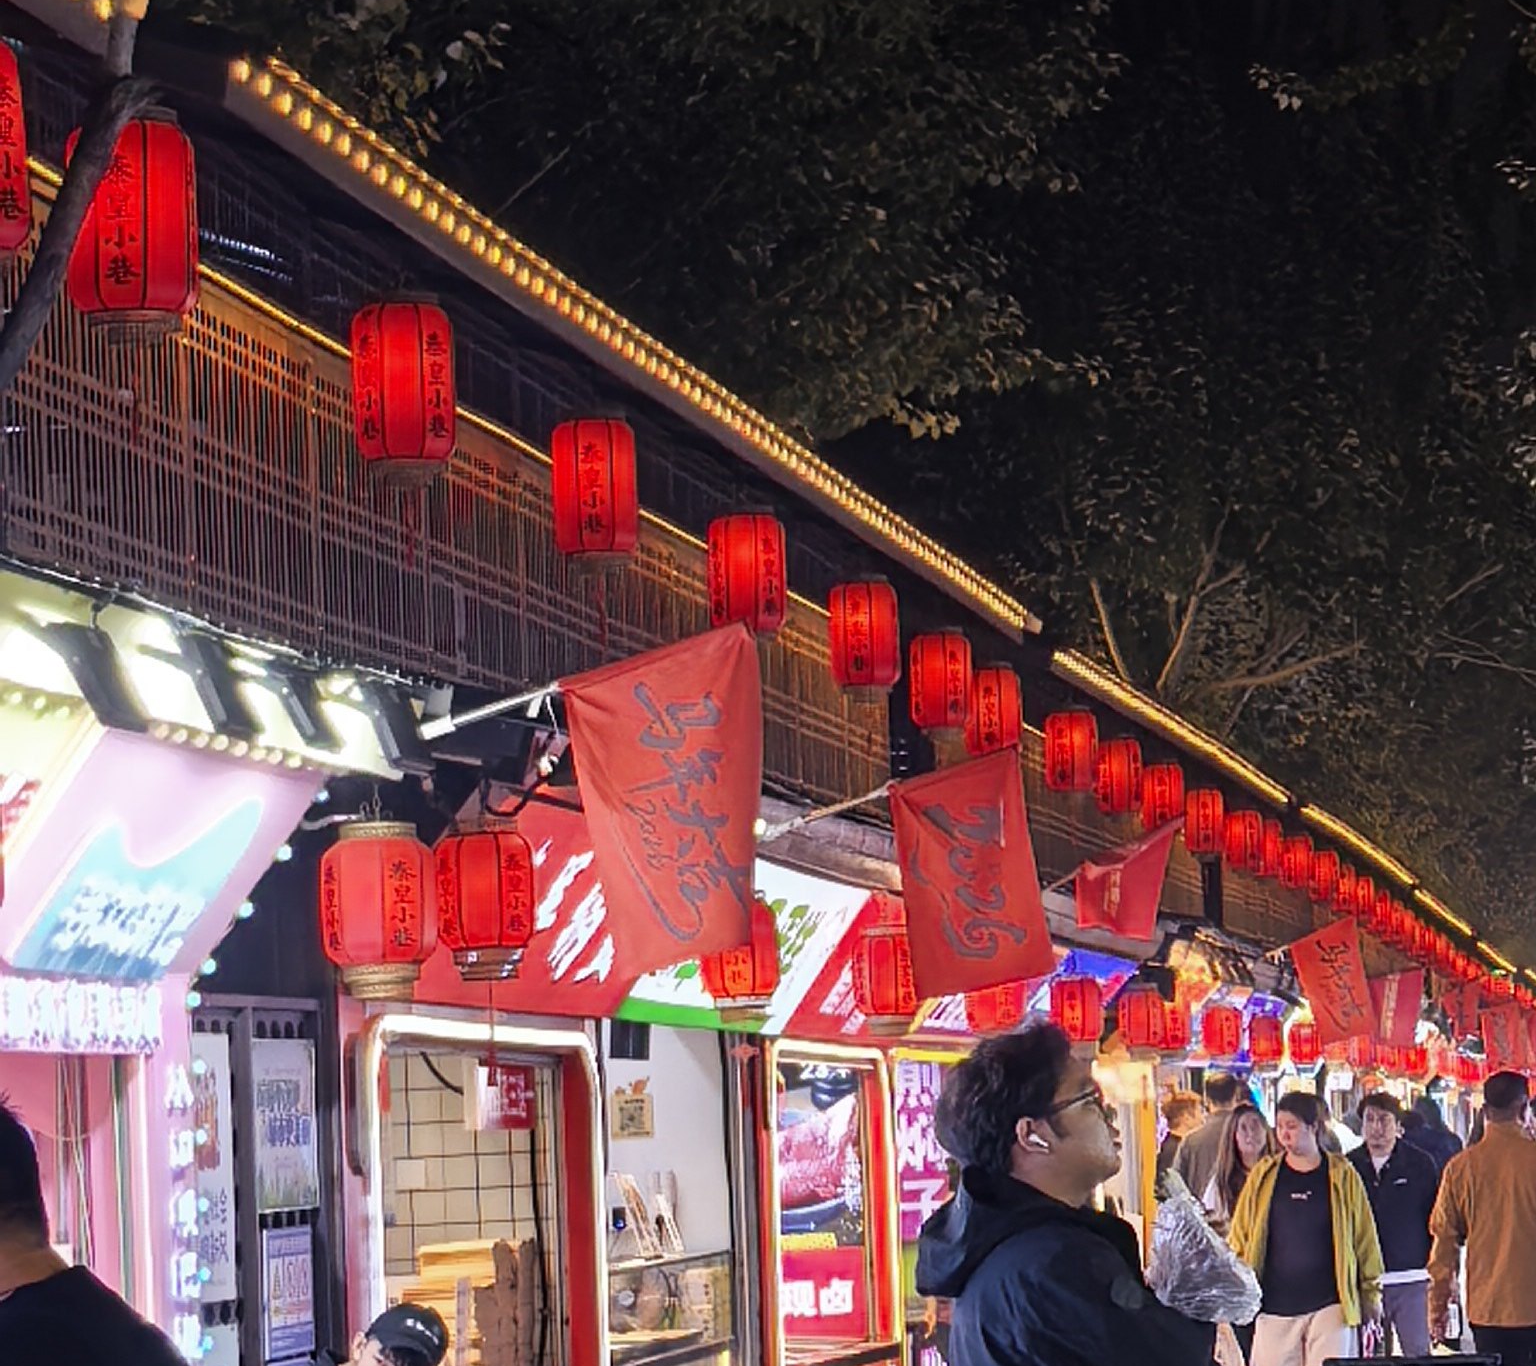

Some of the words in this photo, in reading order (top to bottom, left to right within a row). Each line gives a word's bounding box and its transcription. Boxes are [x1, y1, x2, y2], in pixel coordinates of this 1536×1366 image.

[103, 153, 139, 286] 秦皇小巷
[388, 857, 416, 949] 秦皇小巷
[502, 854, 527, 933] 秦皇小巷
